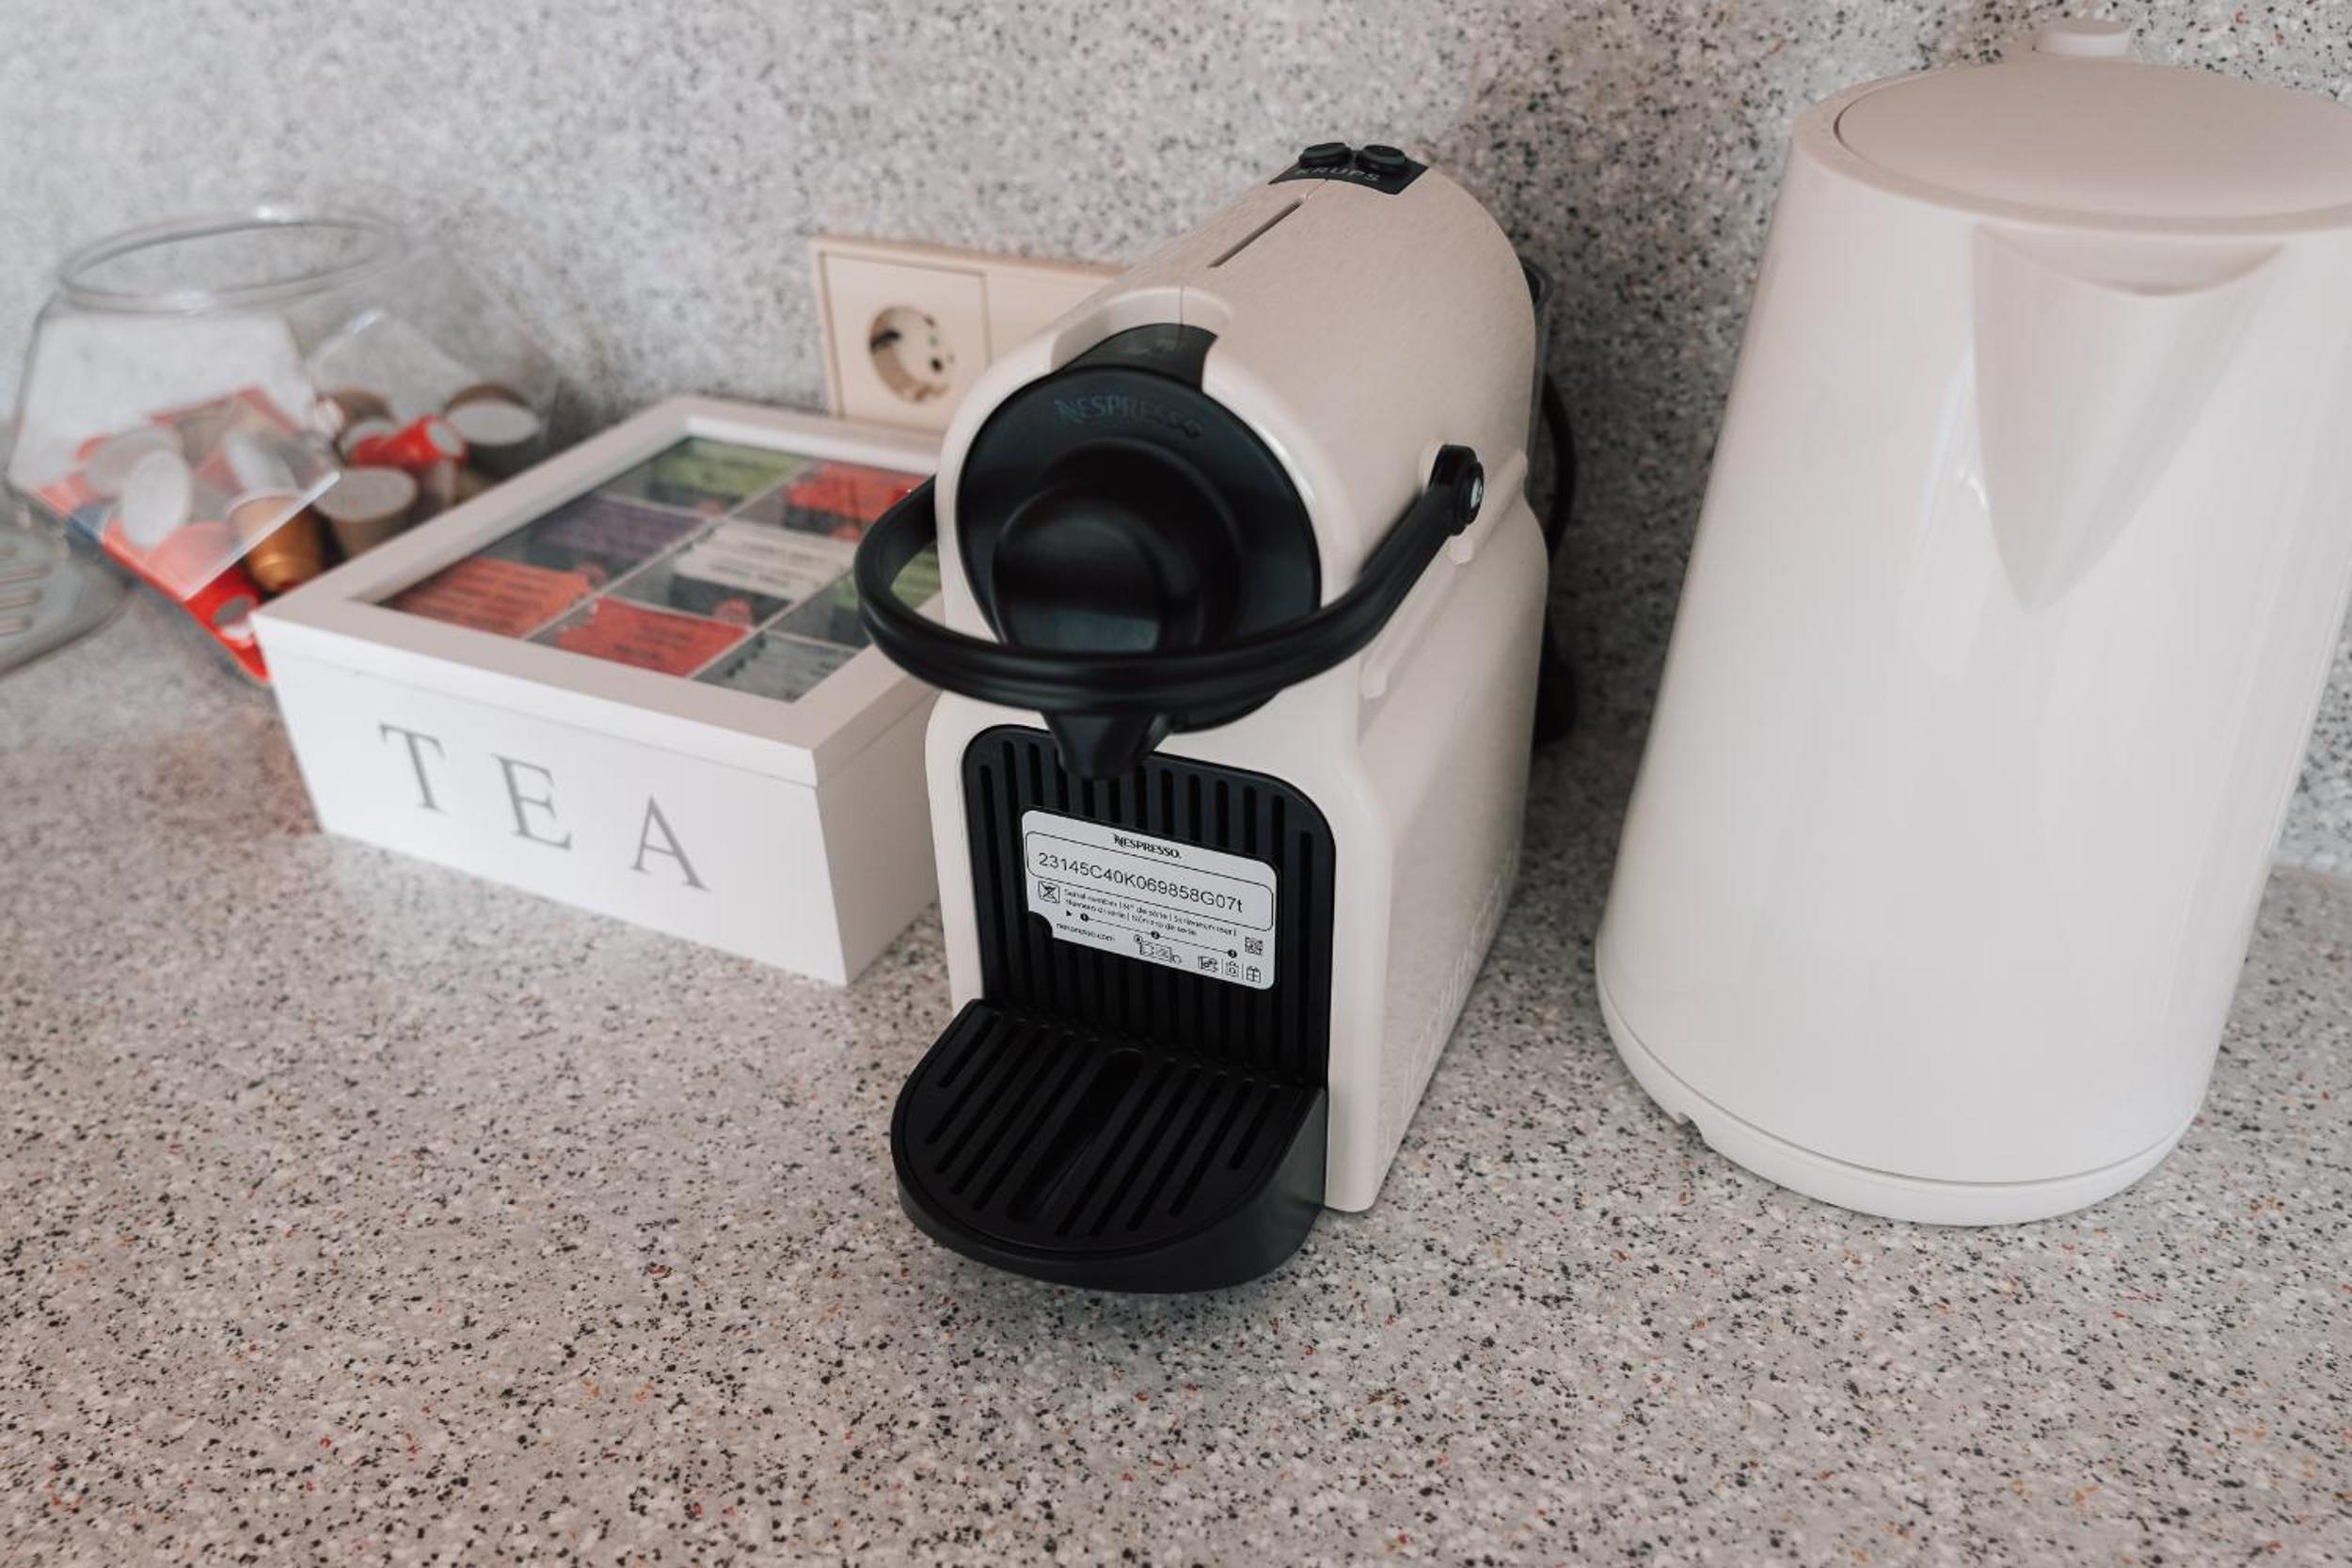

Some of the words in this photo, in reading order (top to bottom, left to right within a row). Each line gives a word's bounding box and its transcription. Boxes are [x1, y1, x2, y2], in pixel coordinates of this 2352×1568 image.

[1054, 394, 1203, 439] NESPRESSO
[378, 722, 711, 893] TEA
[1038, 852, 1243, 913] 23145C40K069858G07t
